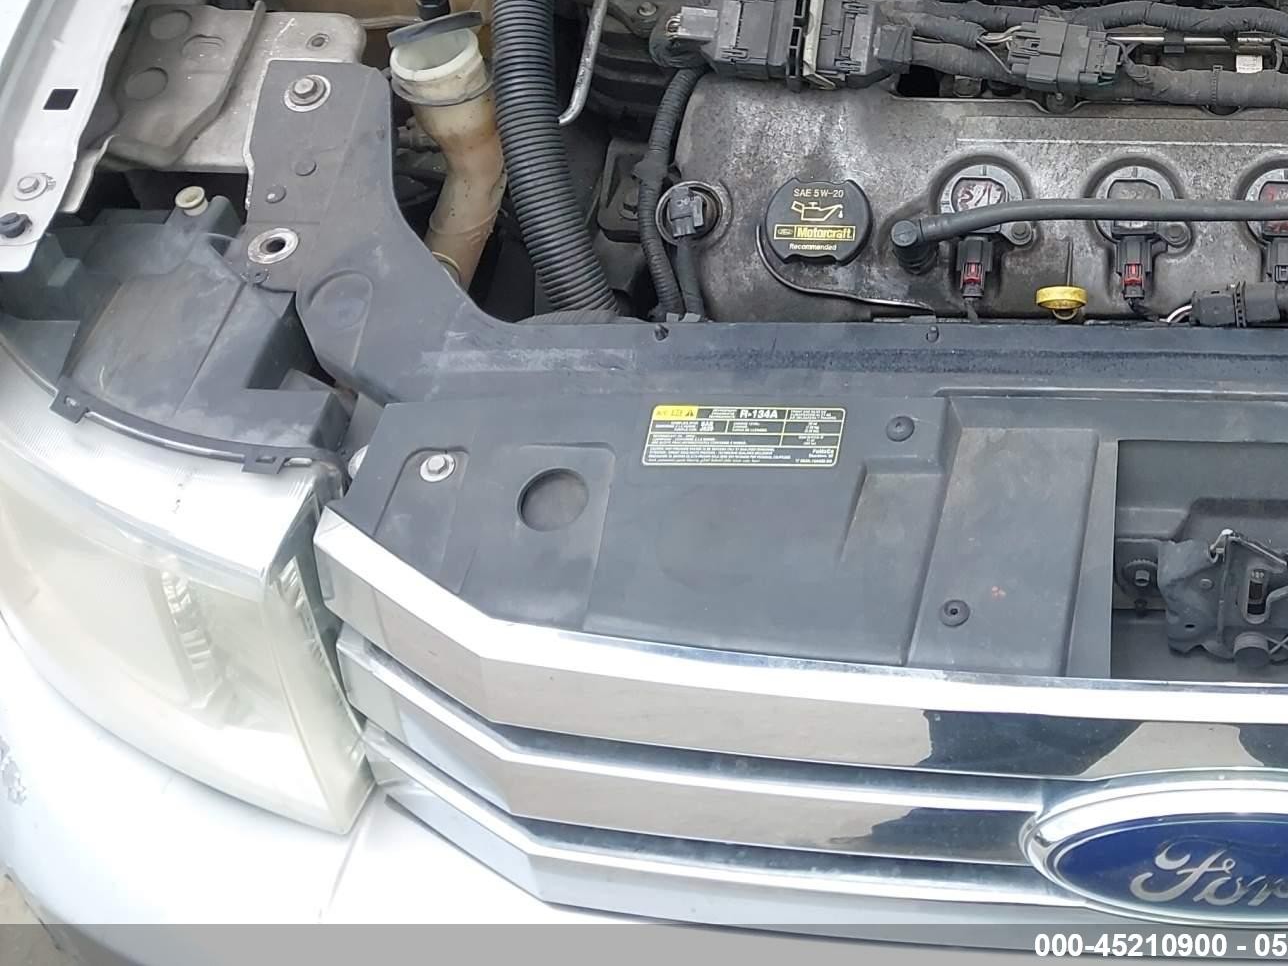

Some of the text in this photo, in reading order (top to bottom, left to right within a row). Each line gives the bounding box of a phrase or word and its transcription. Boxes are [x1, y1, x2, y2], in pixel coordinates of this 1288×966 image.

[793, 189, 844, 198] SAE 5W-20
[797, 226, 850, 239] Motorcraft
[789, 243, 837, 251] Recommended
[739, 409, 779, 419] R-134A
